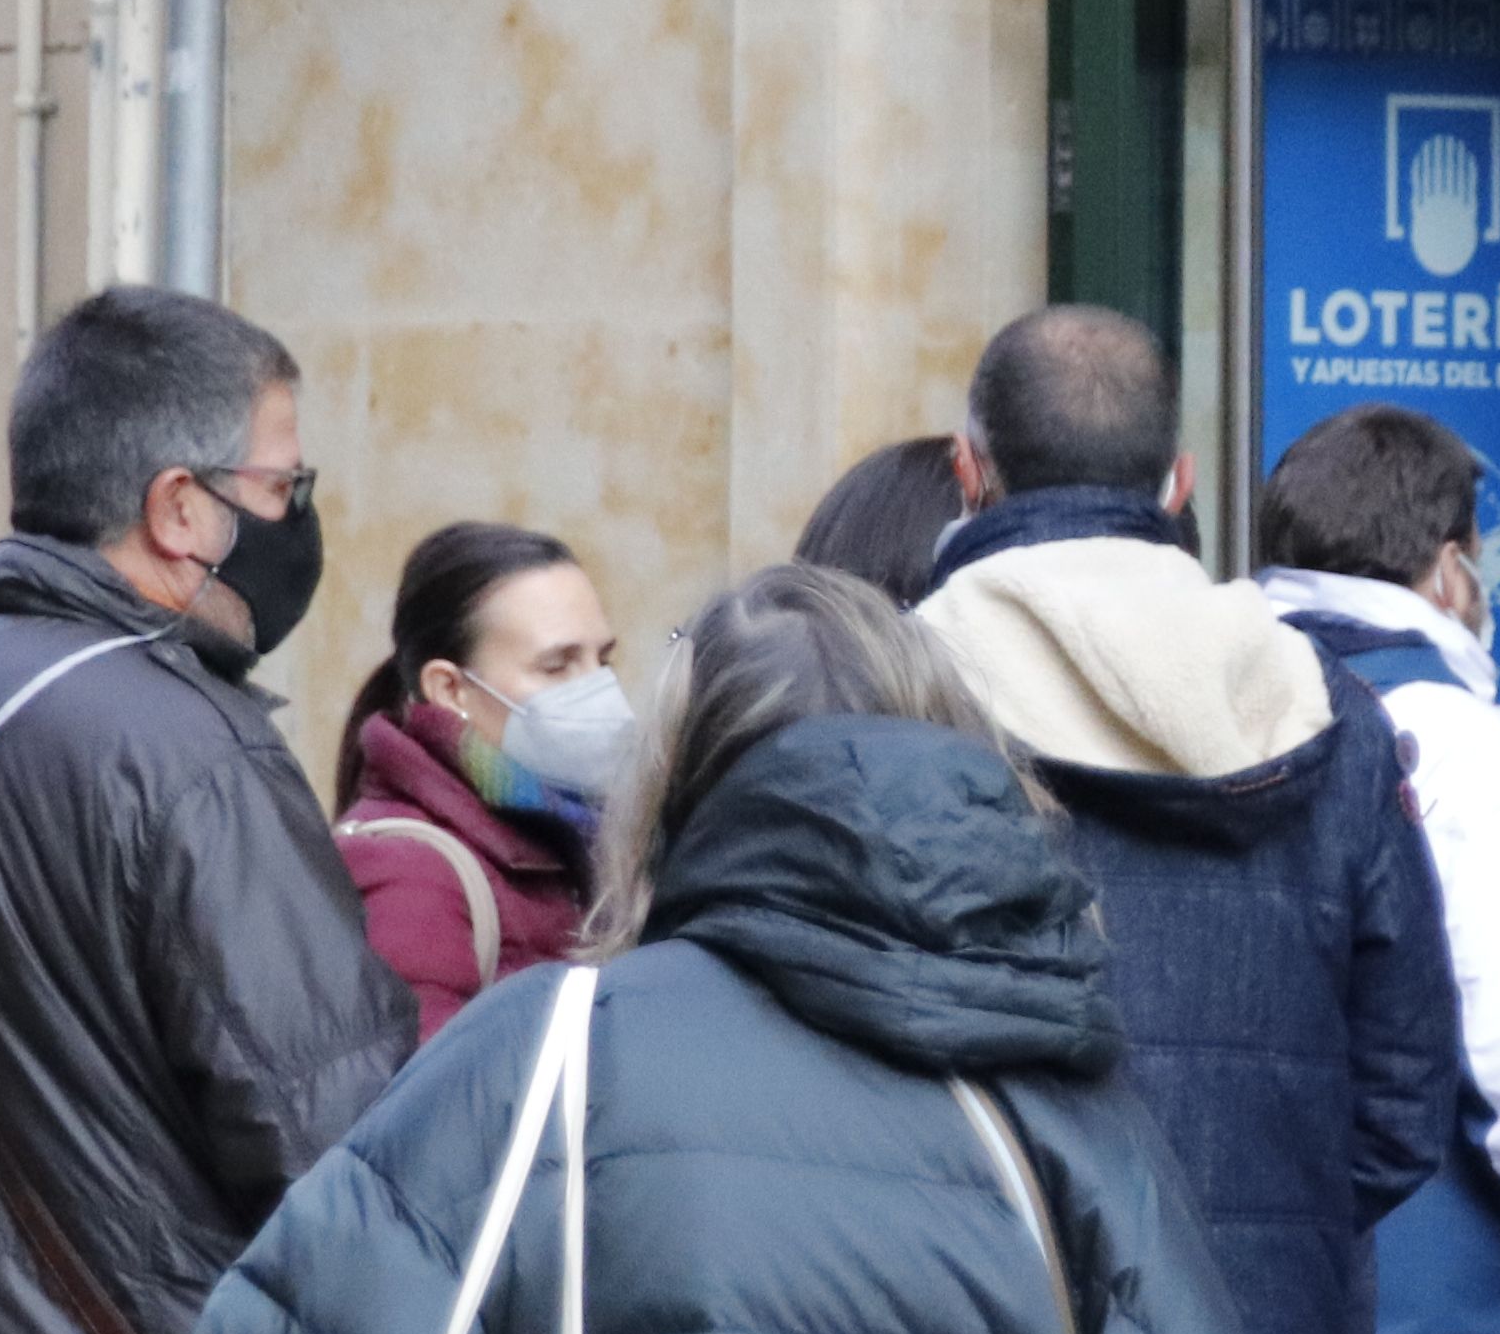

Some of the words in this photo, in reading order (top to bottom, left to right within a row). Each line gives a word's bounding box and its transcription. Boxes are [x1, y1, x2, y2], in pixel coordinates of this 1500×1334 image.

[1291, 357, 1311, 384] Y
[1311, 357, 1440, 387] APUESTAS
[1443, 360, 1492, 389] DEL
